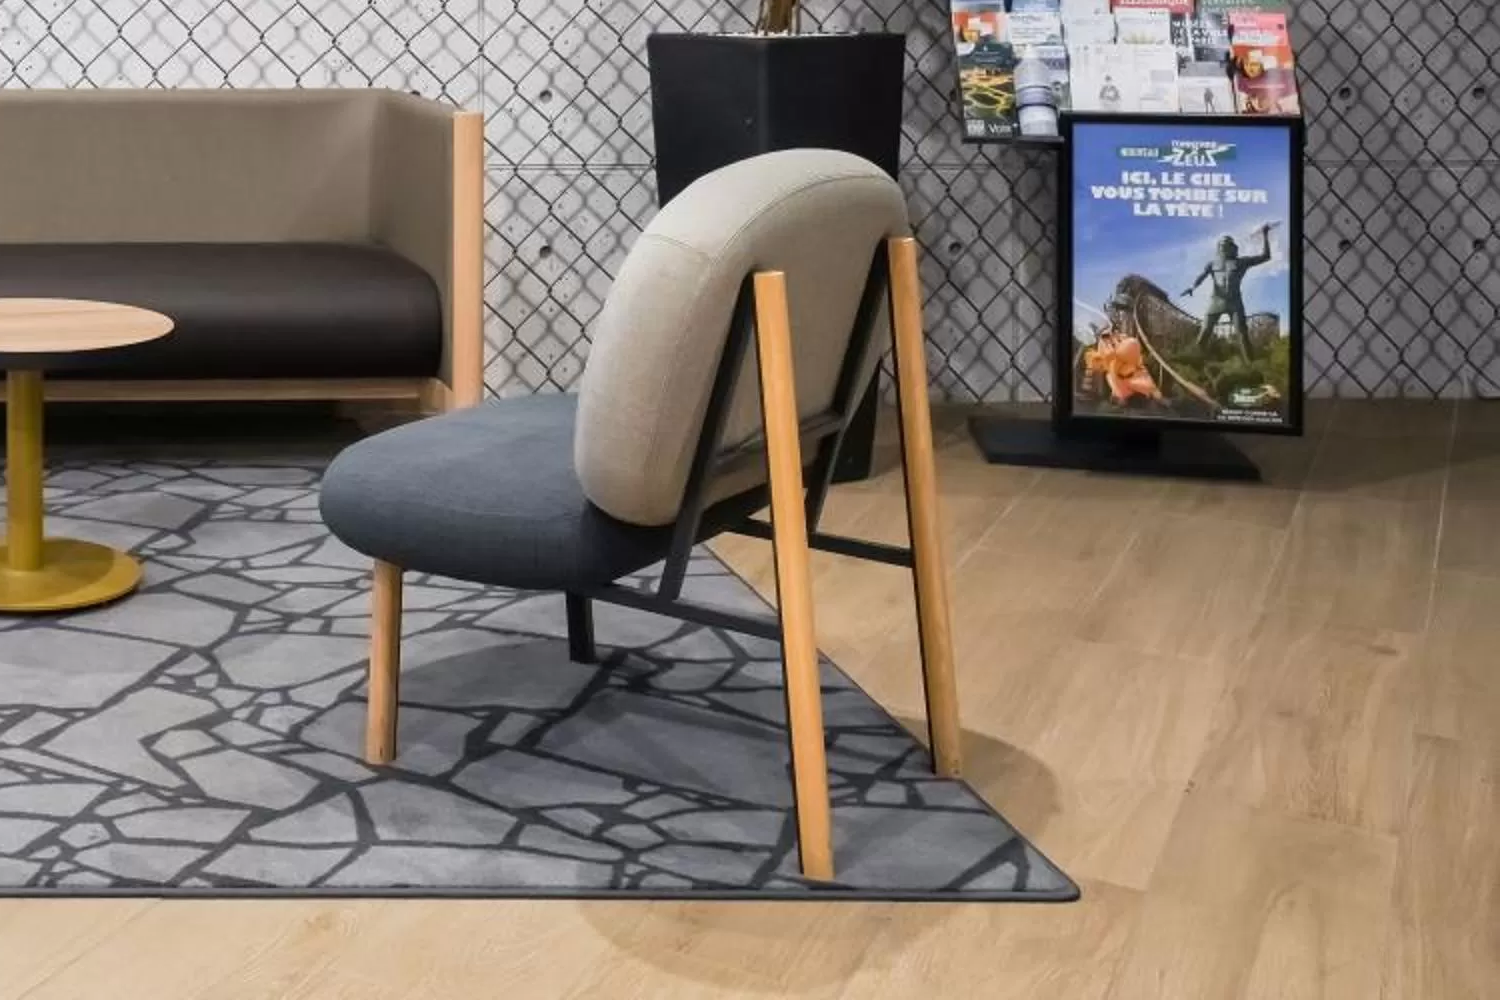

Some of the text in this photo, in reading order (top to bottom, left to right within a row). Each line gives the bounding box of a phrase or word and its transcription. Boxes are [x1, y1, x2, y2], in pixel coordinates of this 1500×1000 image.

[1161, 171, 1185, 186] LE
[1190, 172, 1236, 187] CIEL
[1091, 185, 1269, 204] VOUS TOMBE SUR
[1133, 202, 1162, 217] LA
